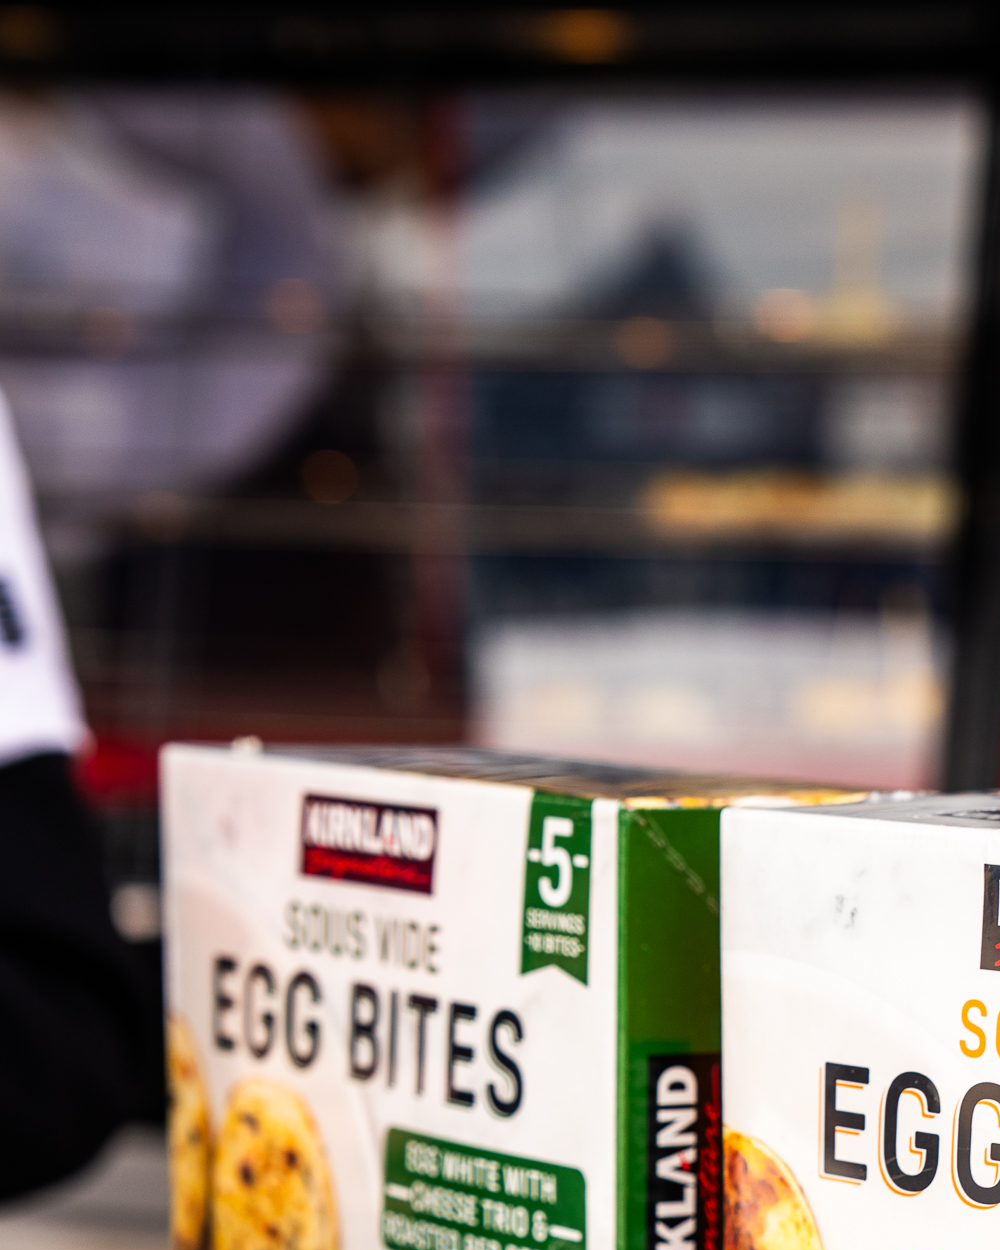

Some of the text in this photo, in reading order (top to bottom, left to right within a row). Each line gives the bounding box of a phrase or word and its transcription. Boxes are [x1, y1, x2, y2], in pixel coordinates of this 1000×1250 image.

[283, 900, 440, 974] SOUS VIDE
[213, 955, 524, 1117] EGG BITES
[442, 1150, 501, 1192] WHITE
[502, 1163, 557, 1204] WITH
[481, 1197, 529, 1238] TRIO
